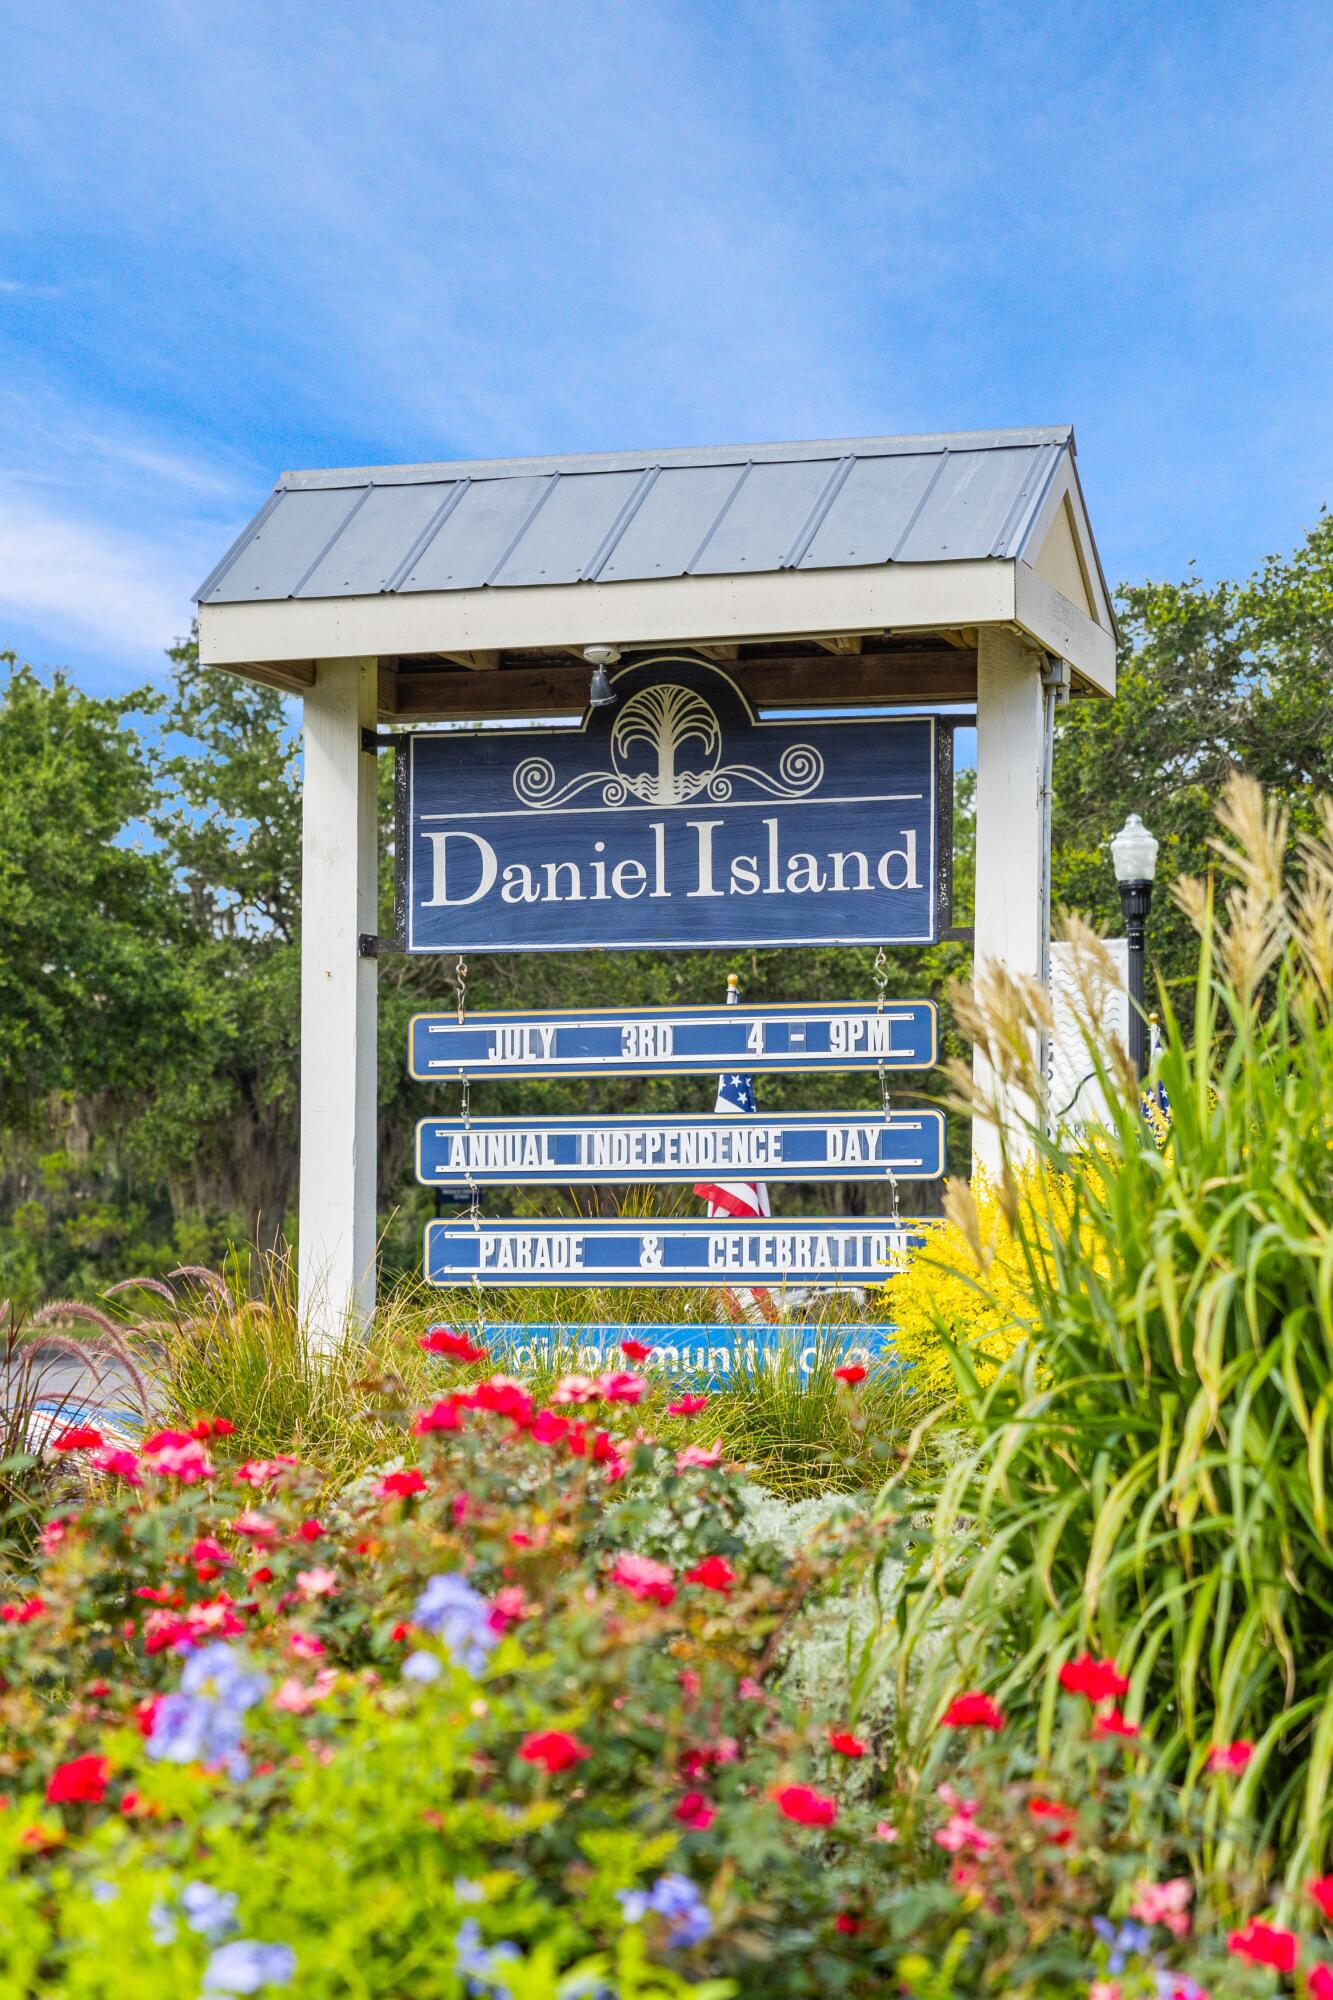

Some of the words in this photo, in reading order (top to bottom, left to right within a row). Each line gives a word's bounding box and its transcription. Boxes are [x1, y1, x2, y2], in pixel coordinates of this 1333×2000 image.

[420, 823, 672, 908] Daniel
[686, 818, 924, 897] Island
[488, 1026, 556, 1061] JULY
[621, 1024, 674, 1058] 3RD
[747, 1020, 764, 1056] 4
[790, 1033, 805, 1042] -
[830, 1018, 890, 1055] 9PM
[450, 1132, 555, 1168] ANNUAL
[580, 1129, 783, 1167] INDEPENDENCE
[827, 1128, 882, 1164] DAY
[479, 1235, 584, 1270] PARADE
[639, 1235, 663, 1270] &
[707, 1233, 911, 1269] CELEBRATION
